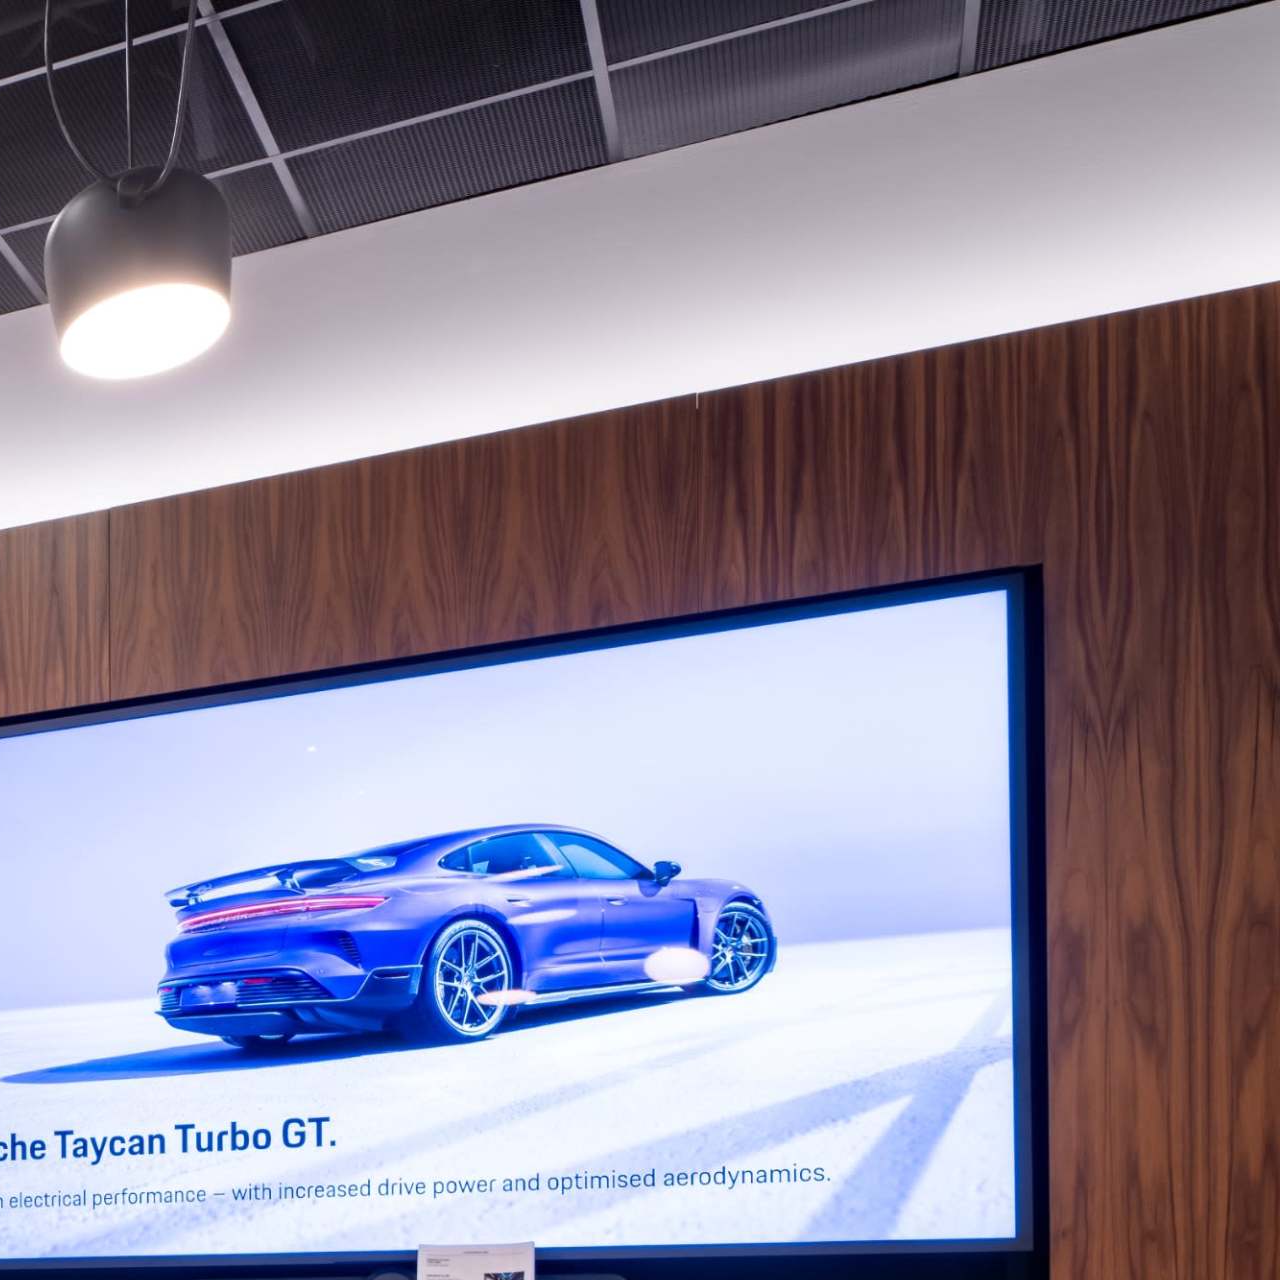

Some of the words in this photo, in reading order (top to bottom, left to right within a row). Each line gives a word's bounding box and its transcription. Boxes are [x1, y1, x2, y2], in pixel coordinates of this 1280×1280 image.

[54, 1129, 166, 1165] Taycan
[174, 1121, 272, 1153] Turbo
[282, 1116, 337, 1148] GT.
[9, 1189, 87, 1209] electrical
[92, 1185, 207, 1210] performance
[232, 1182, 272, 1201] with
[278, 1178, 371, 1200] increased
[378, 1177, 426, 1196] drive
[433, 1177, 496, 1199] power
[502, 1174, 540, 1192] and
[547, 1169, 656, 1193] optimised
[663, 1163, 831, 1189] aerodynamics.
